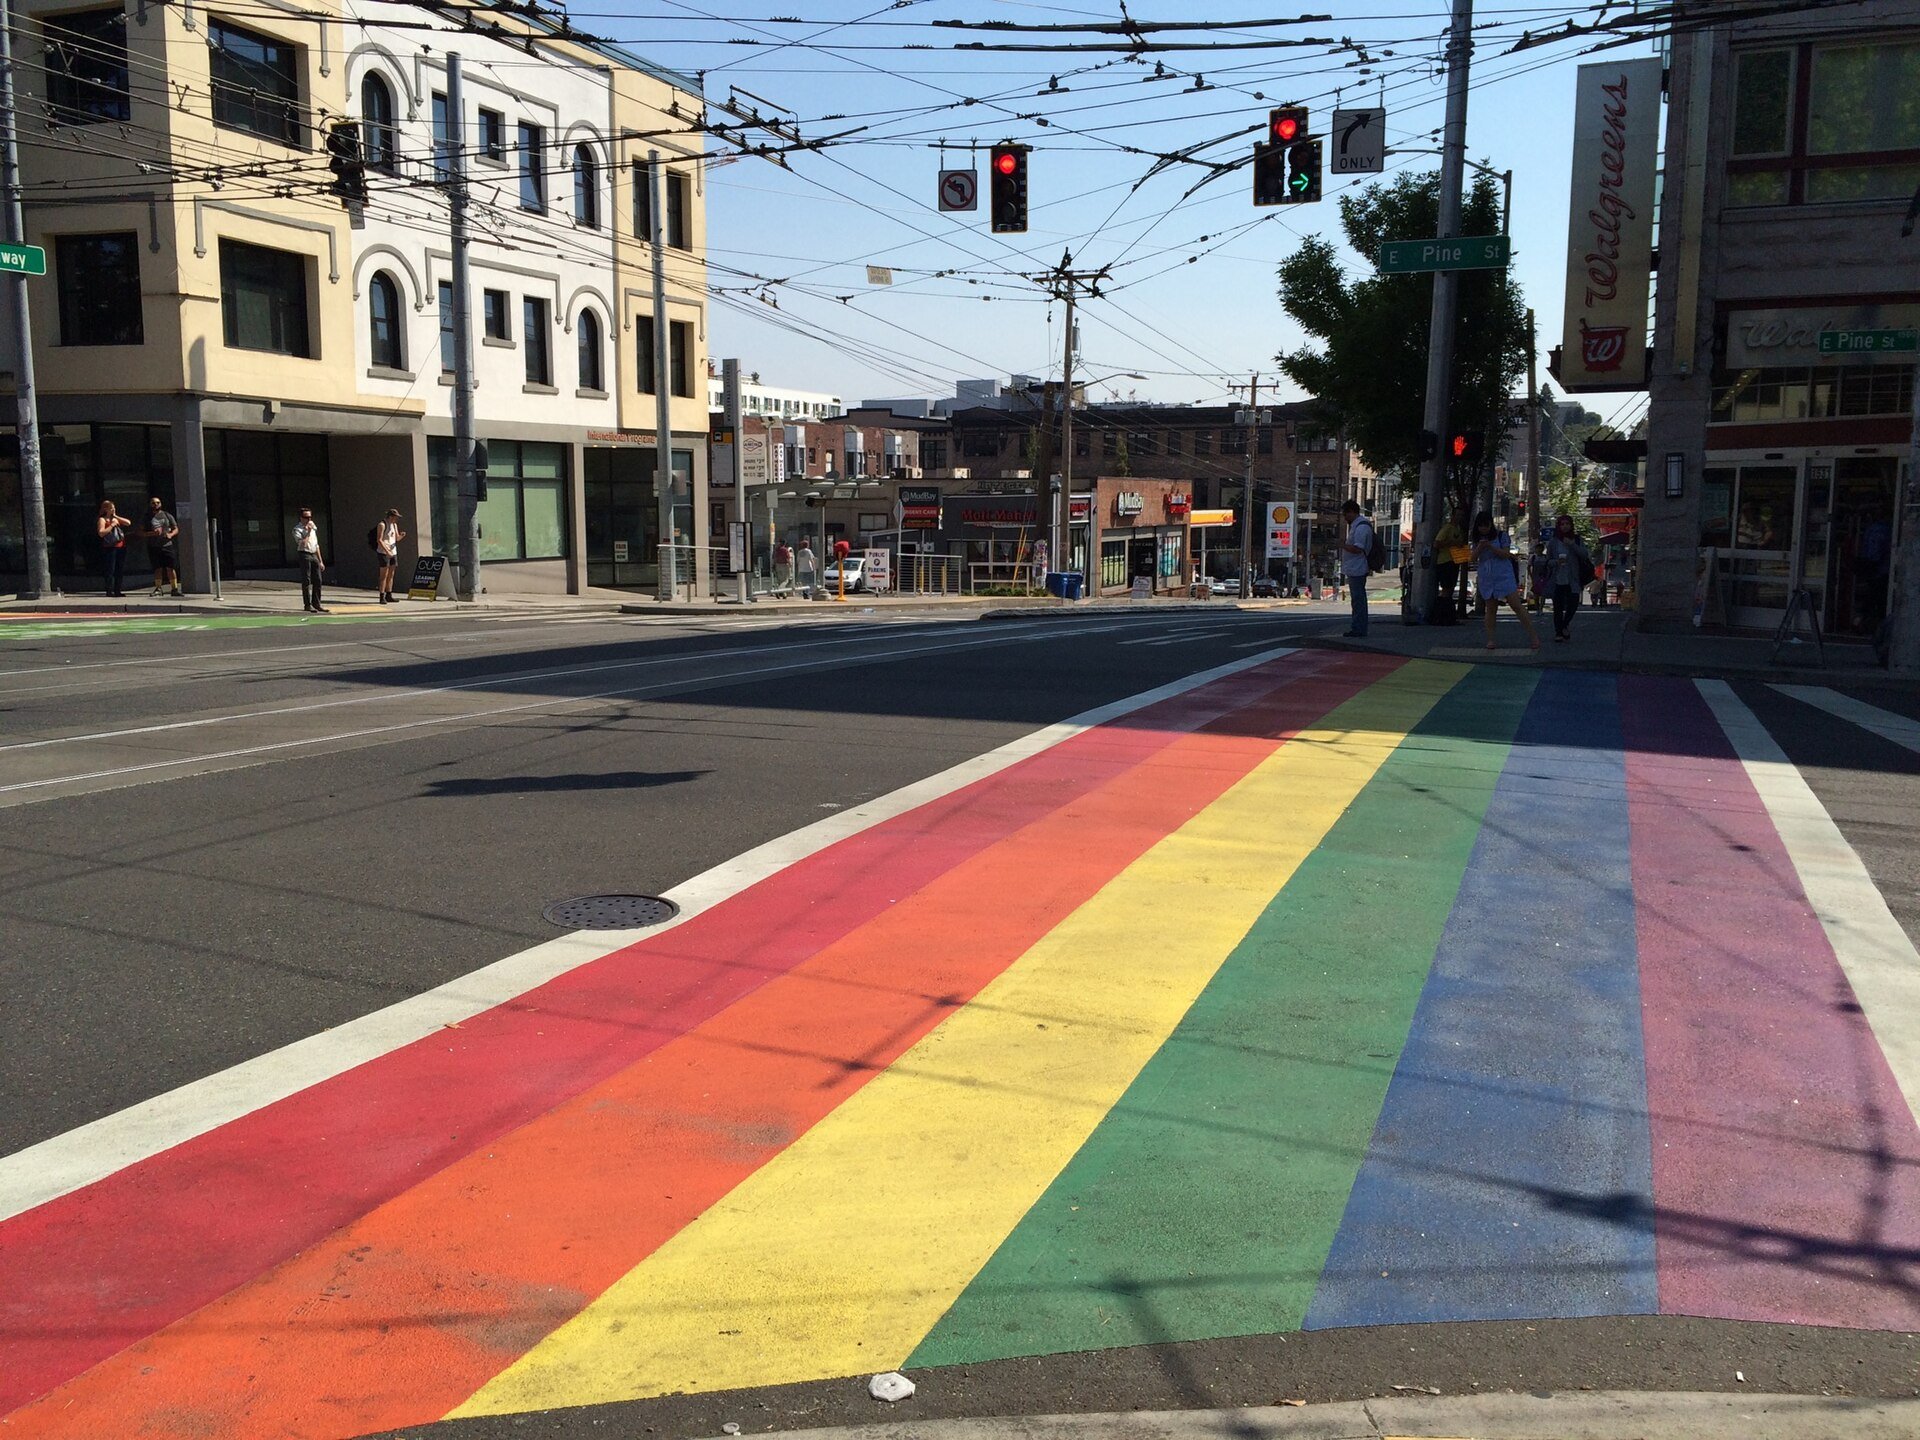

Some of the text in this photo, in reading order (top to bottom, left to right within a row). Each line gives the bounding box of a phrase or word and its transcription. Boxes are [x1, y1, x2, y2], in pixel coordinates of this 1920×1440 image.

[1340, 156, 1375, 169] ONLY
[1585, 74, 1636, 308] Walgreens
[1390, 244, 1501, 264] E Pine St
[1823, 338, 1831, 349] E
[1838, 332, 1874, 349] Pine
[1882, 336, 1895, 348] St
[910, 491, 937, 501] MudBay
